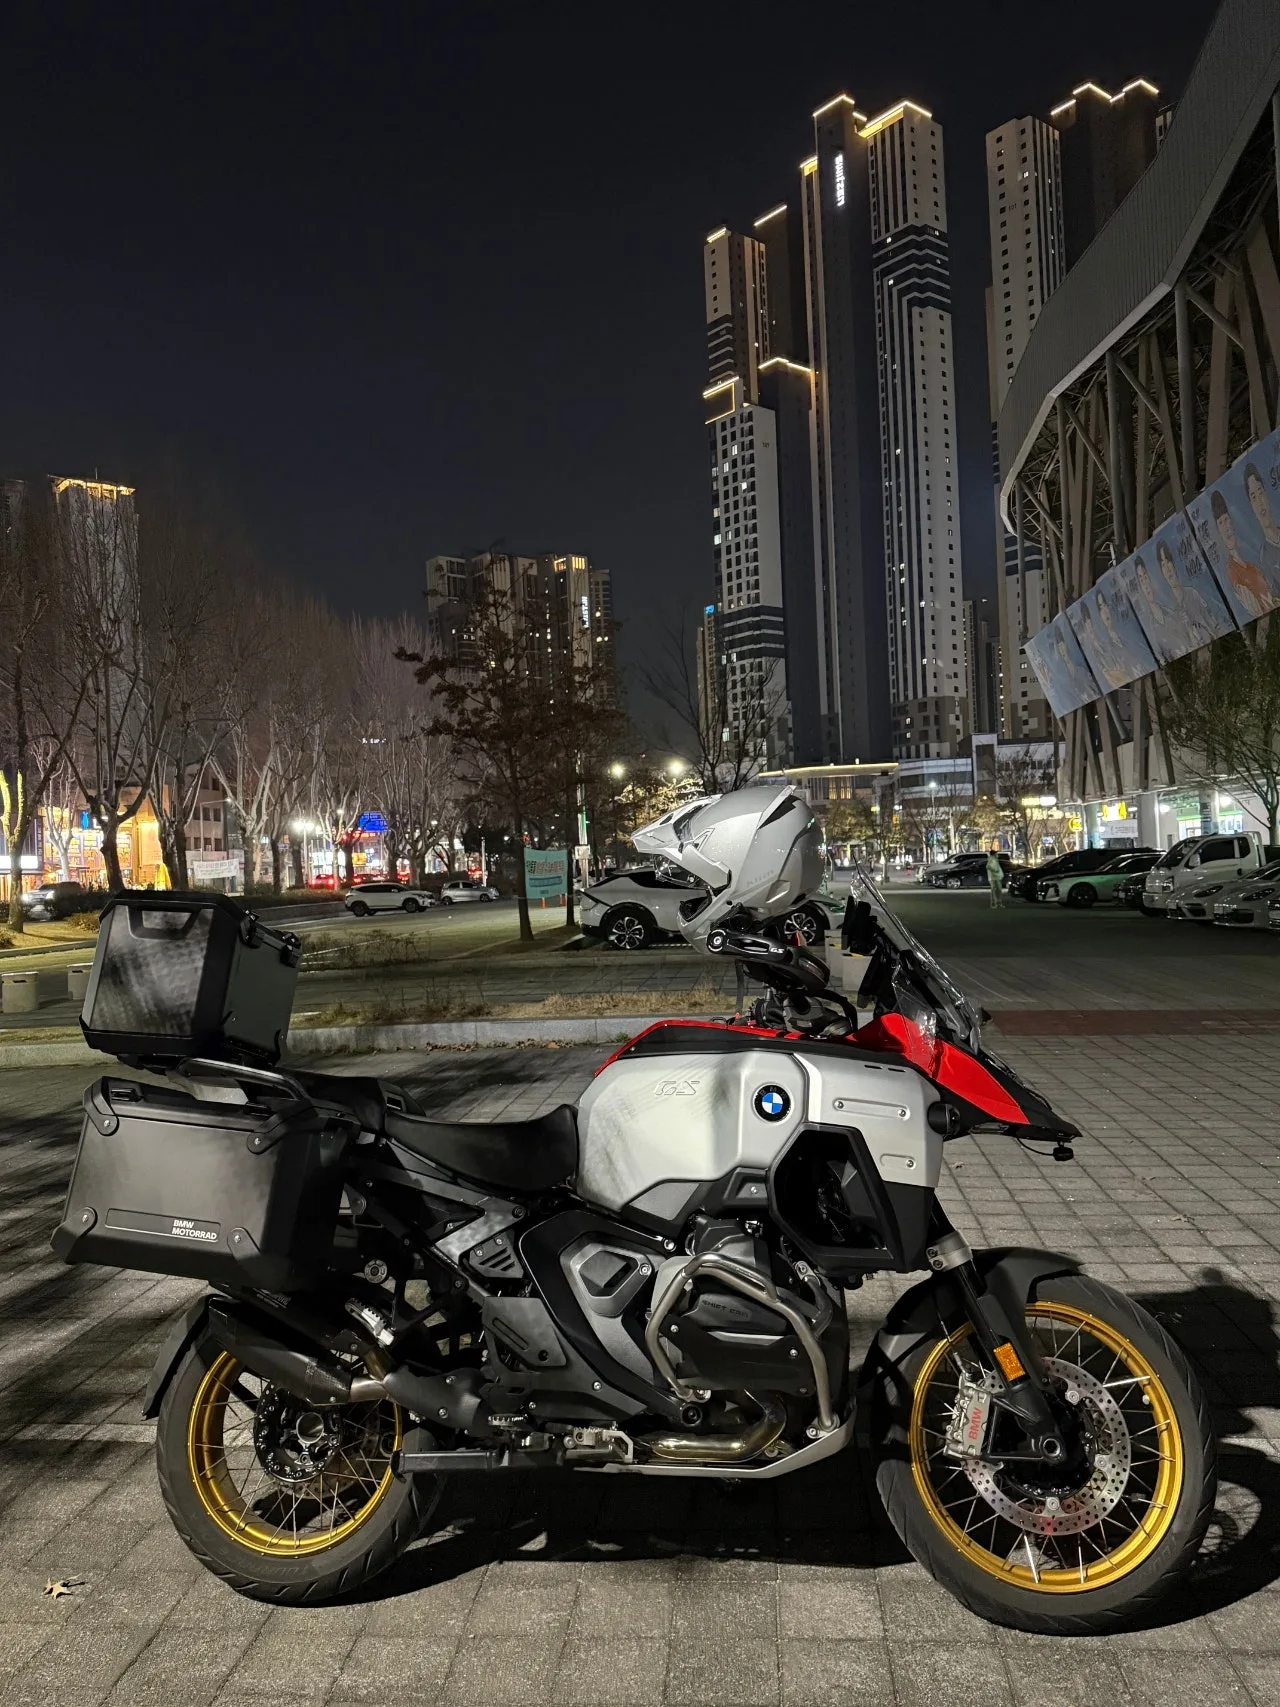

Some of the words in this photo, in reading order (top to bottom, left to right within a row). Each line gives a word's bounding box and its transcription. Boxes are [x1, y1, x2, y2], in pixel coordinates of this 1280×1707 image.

[653, 1080, 701, 1096] GS
[173, 1219, 195, 1229] BMW
[171, 1227, 217, 1240] MOTORRAD
[968, 1408, 982, 1440] BMW
